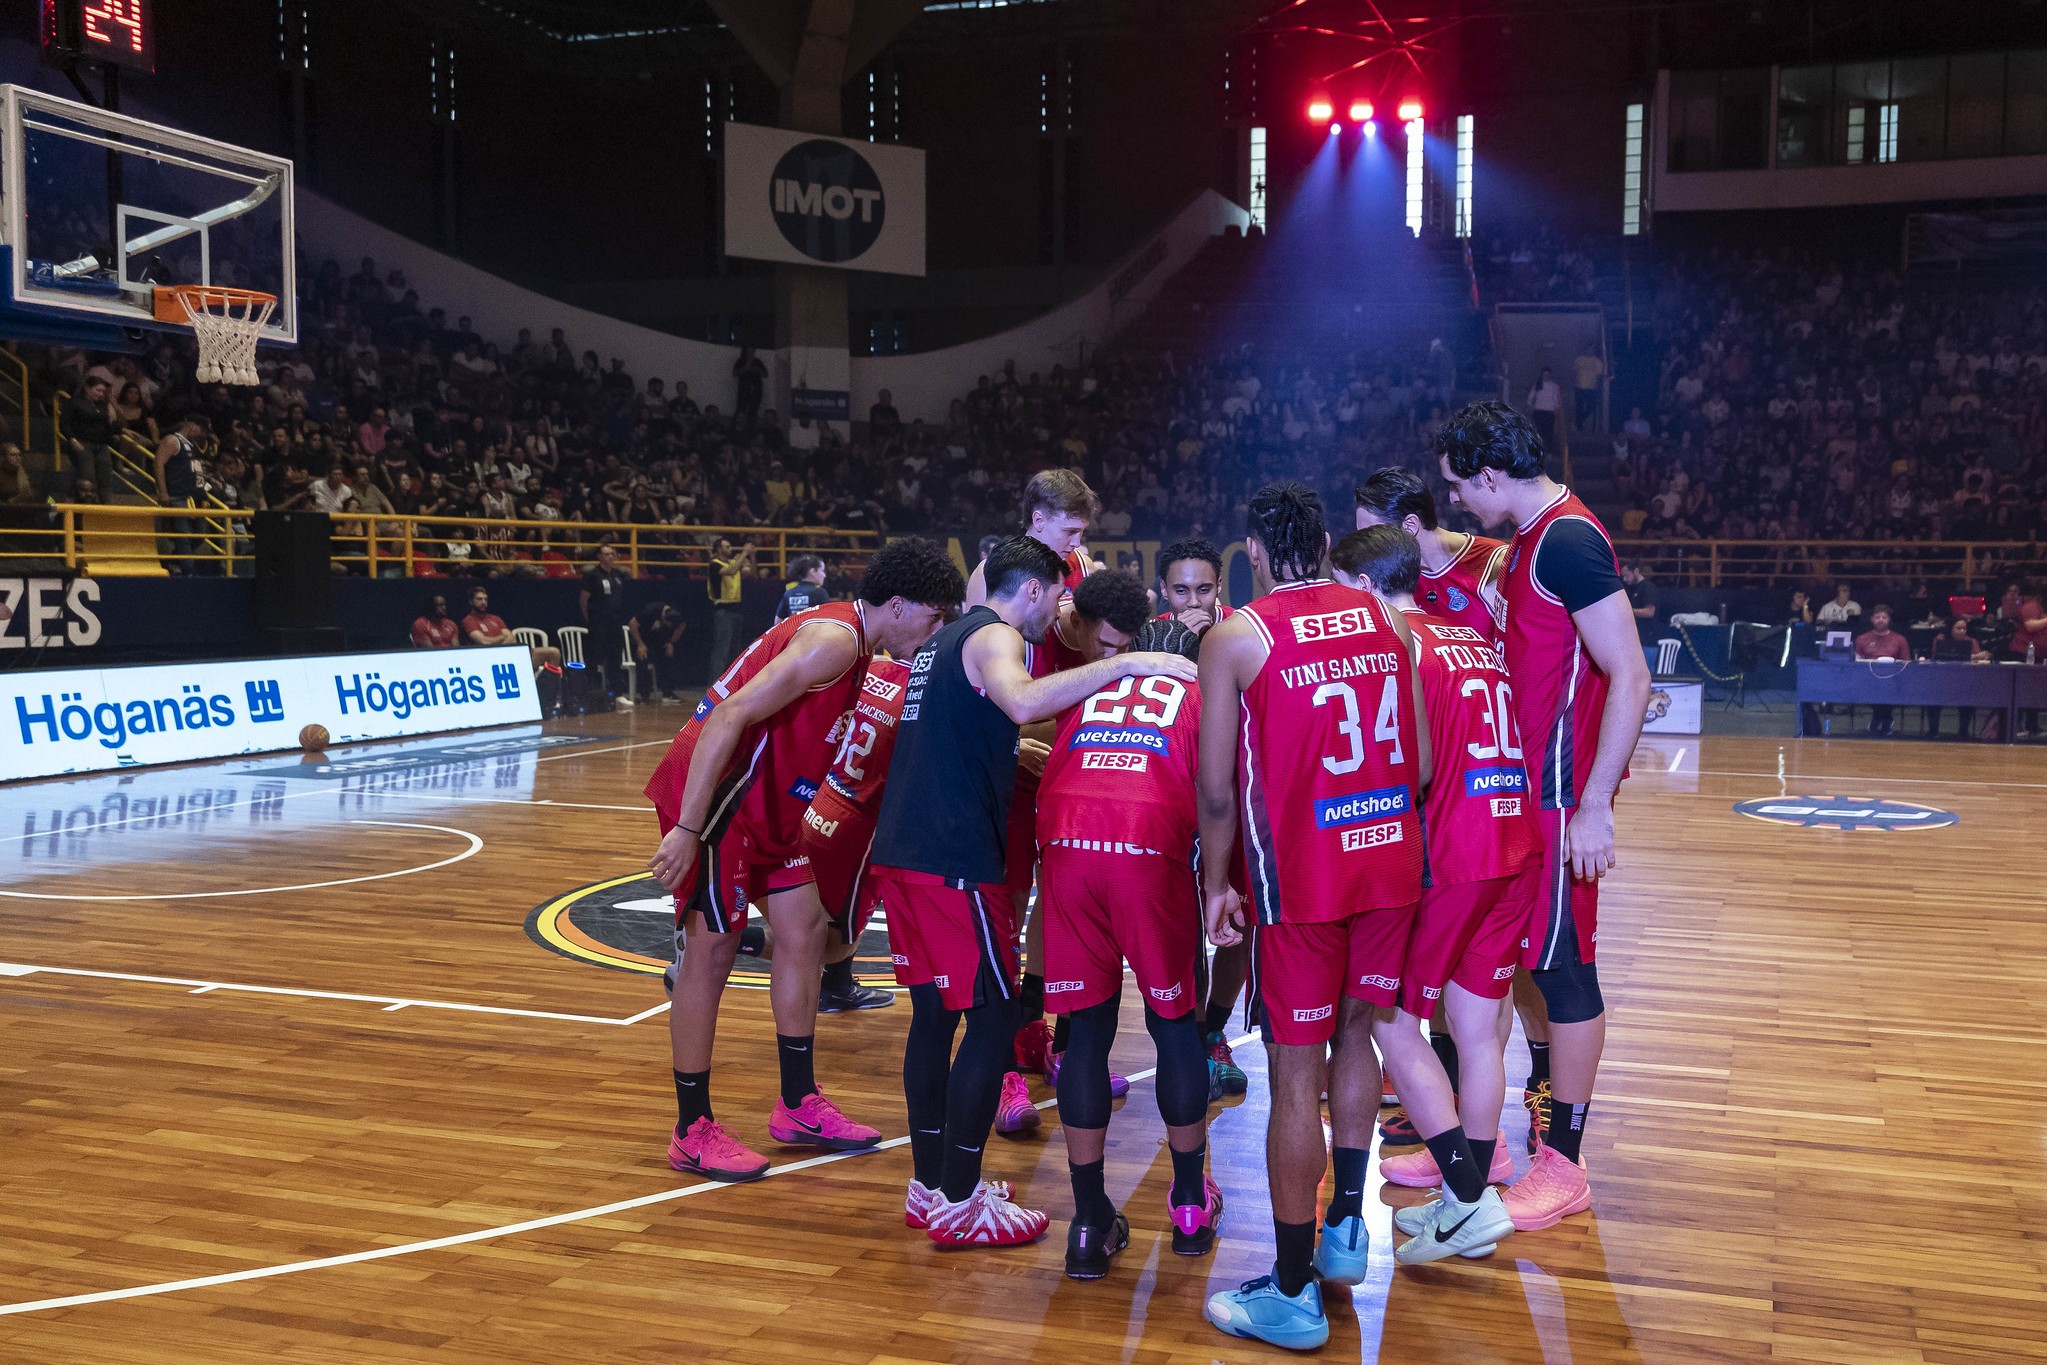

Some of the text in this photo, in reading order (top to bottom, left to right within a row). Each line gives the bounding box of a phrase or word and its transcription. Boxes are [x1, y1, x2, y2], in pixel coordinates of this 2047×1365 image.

[84, 0, 142, 52] 24
[774, 178, 881, 223] IMOT
[1303, 611, 1367, 639] SESI
[1435, 626, 1481, 640] SESI
[1280, 652, 1398, 689] VINI SANTOS
[335, 667, 486, 720] Höganäs
[863, 676, 893, 697] SESI
[1081, 674, 1188, 729] 29
[15, 685, 236, 749] Höganäs
[1312, 675, 1405, 776] 34
[1461, 678, 1524, 760] 30
[1087, 754, 1143, 769] FIESP
[1347, 825, 1398, 848] FIESP
[1048, 982, 1081, 992] FIESP
[1153, 984, 1180, 1000] SESI
[1364, 976, 1398, 989] SESI
[1297, 1007, 1331, 1020] FIESP
[1570, 1114, 1583, 1131] NIKE
